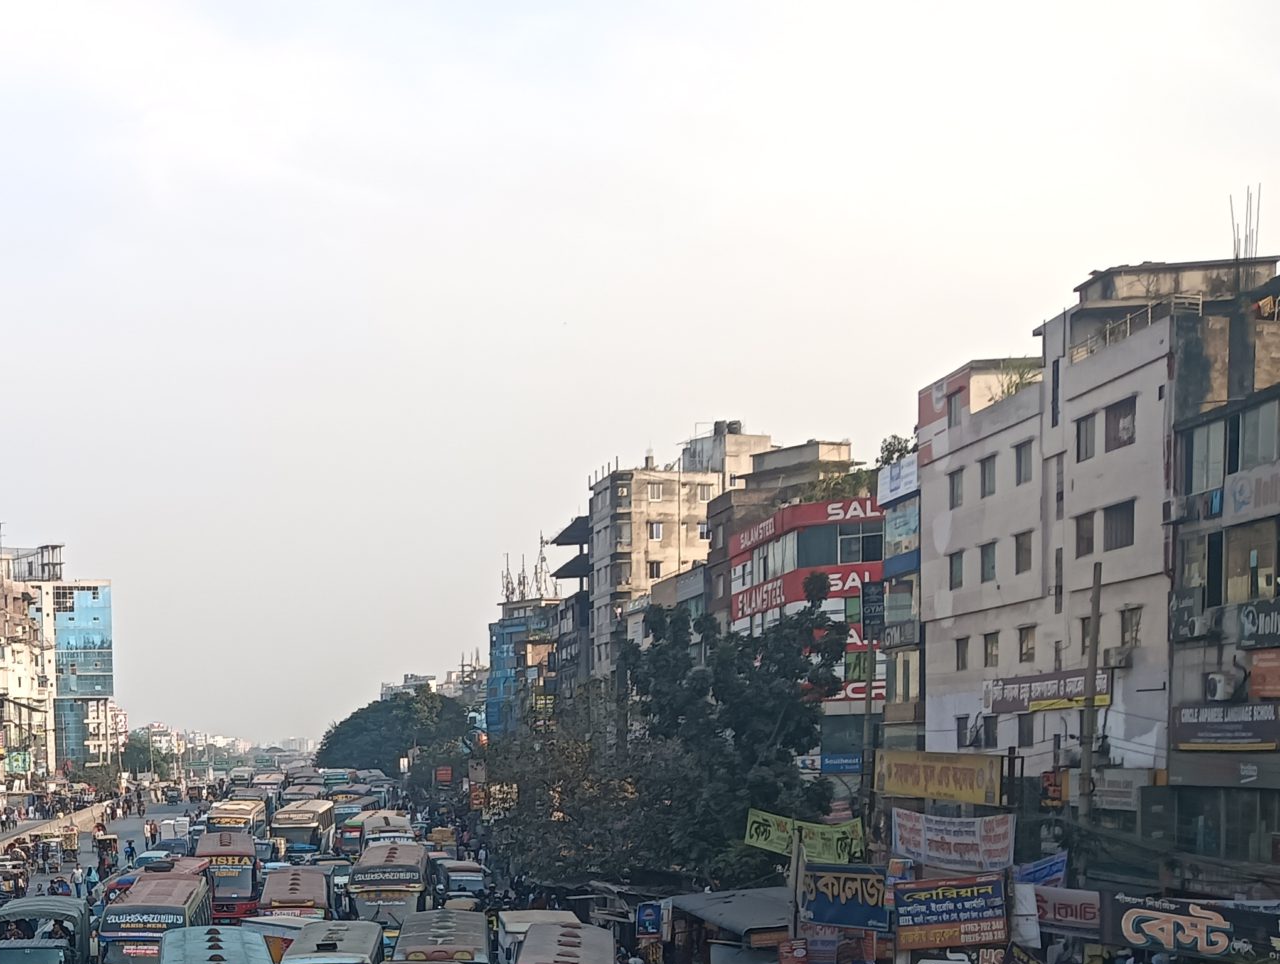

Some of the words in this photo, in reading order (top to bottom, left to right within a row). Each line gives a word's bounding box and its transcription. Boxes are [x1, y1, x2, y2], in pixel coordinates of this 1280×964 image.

[827, 500, 886, 521] SAL
[740, 525, 759, 549] SALAM
[759, 517, 775, 540] STEEL
[738, 586, 763, 617] SALAM
[763, 579, 785, 608] STEEL
[864, 606, 884, 614] GYM
[884, 628, 902, 648] GYM
[1224, 705, 1252, 722] LANGUAGE
[1253, 704, 1275, 721] SCHOOL
[749, 818, 772, 841] বেস্ট
[208, 856, 251, 865] ISHA
[816, 872, 885, 908] কলেজ
[903, 885, 993, 902] কোরিয়ান
[1121, 904, 1233, 956] বেস্ট
